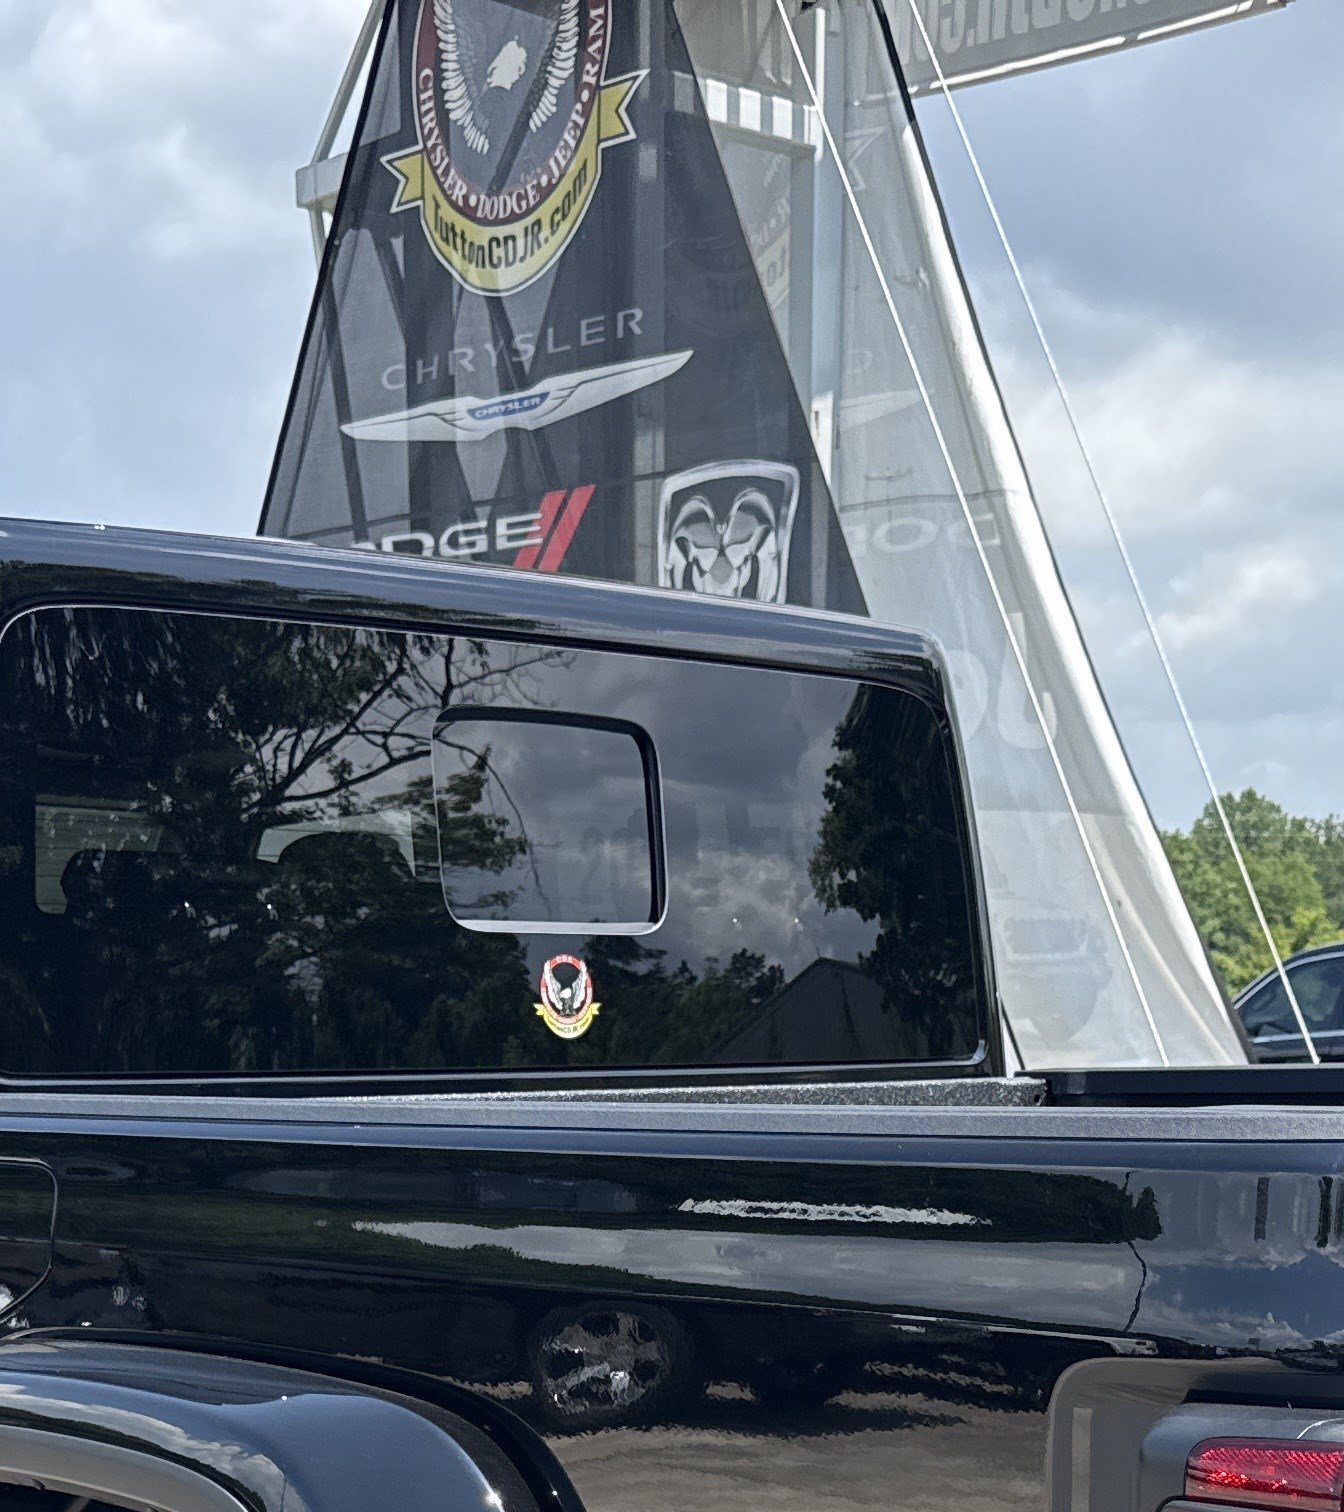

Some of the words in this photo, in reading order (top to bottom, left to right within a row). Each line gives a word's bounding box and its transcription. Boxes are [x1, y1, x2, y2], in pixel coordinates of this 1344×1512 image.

[418, 67, 467, 207] CHRYSLER
[477, 181, 541, 220] DODGE
[548, 102, 586, 184] JEEP
[582, 6, 605, 86] RAM
[432, 158, 588, 270] TuttonCDJR.com
[381, 307, 644, 391] CHRYSLER
[350, 512, 544, 558] DGE
